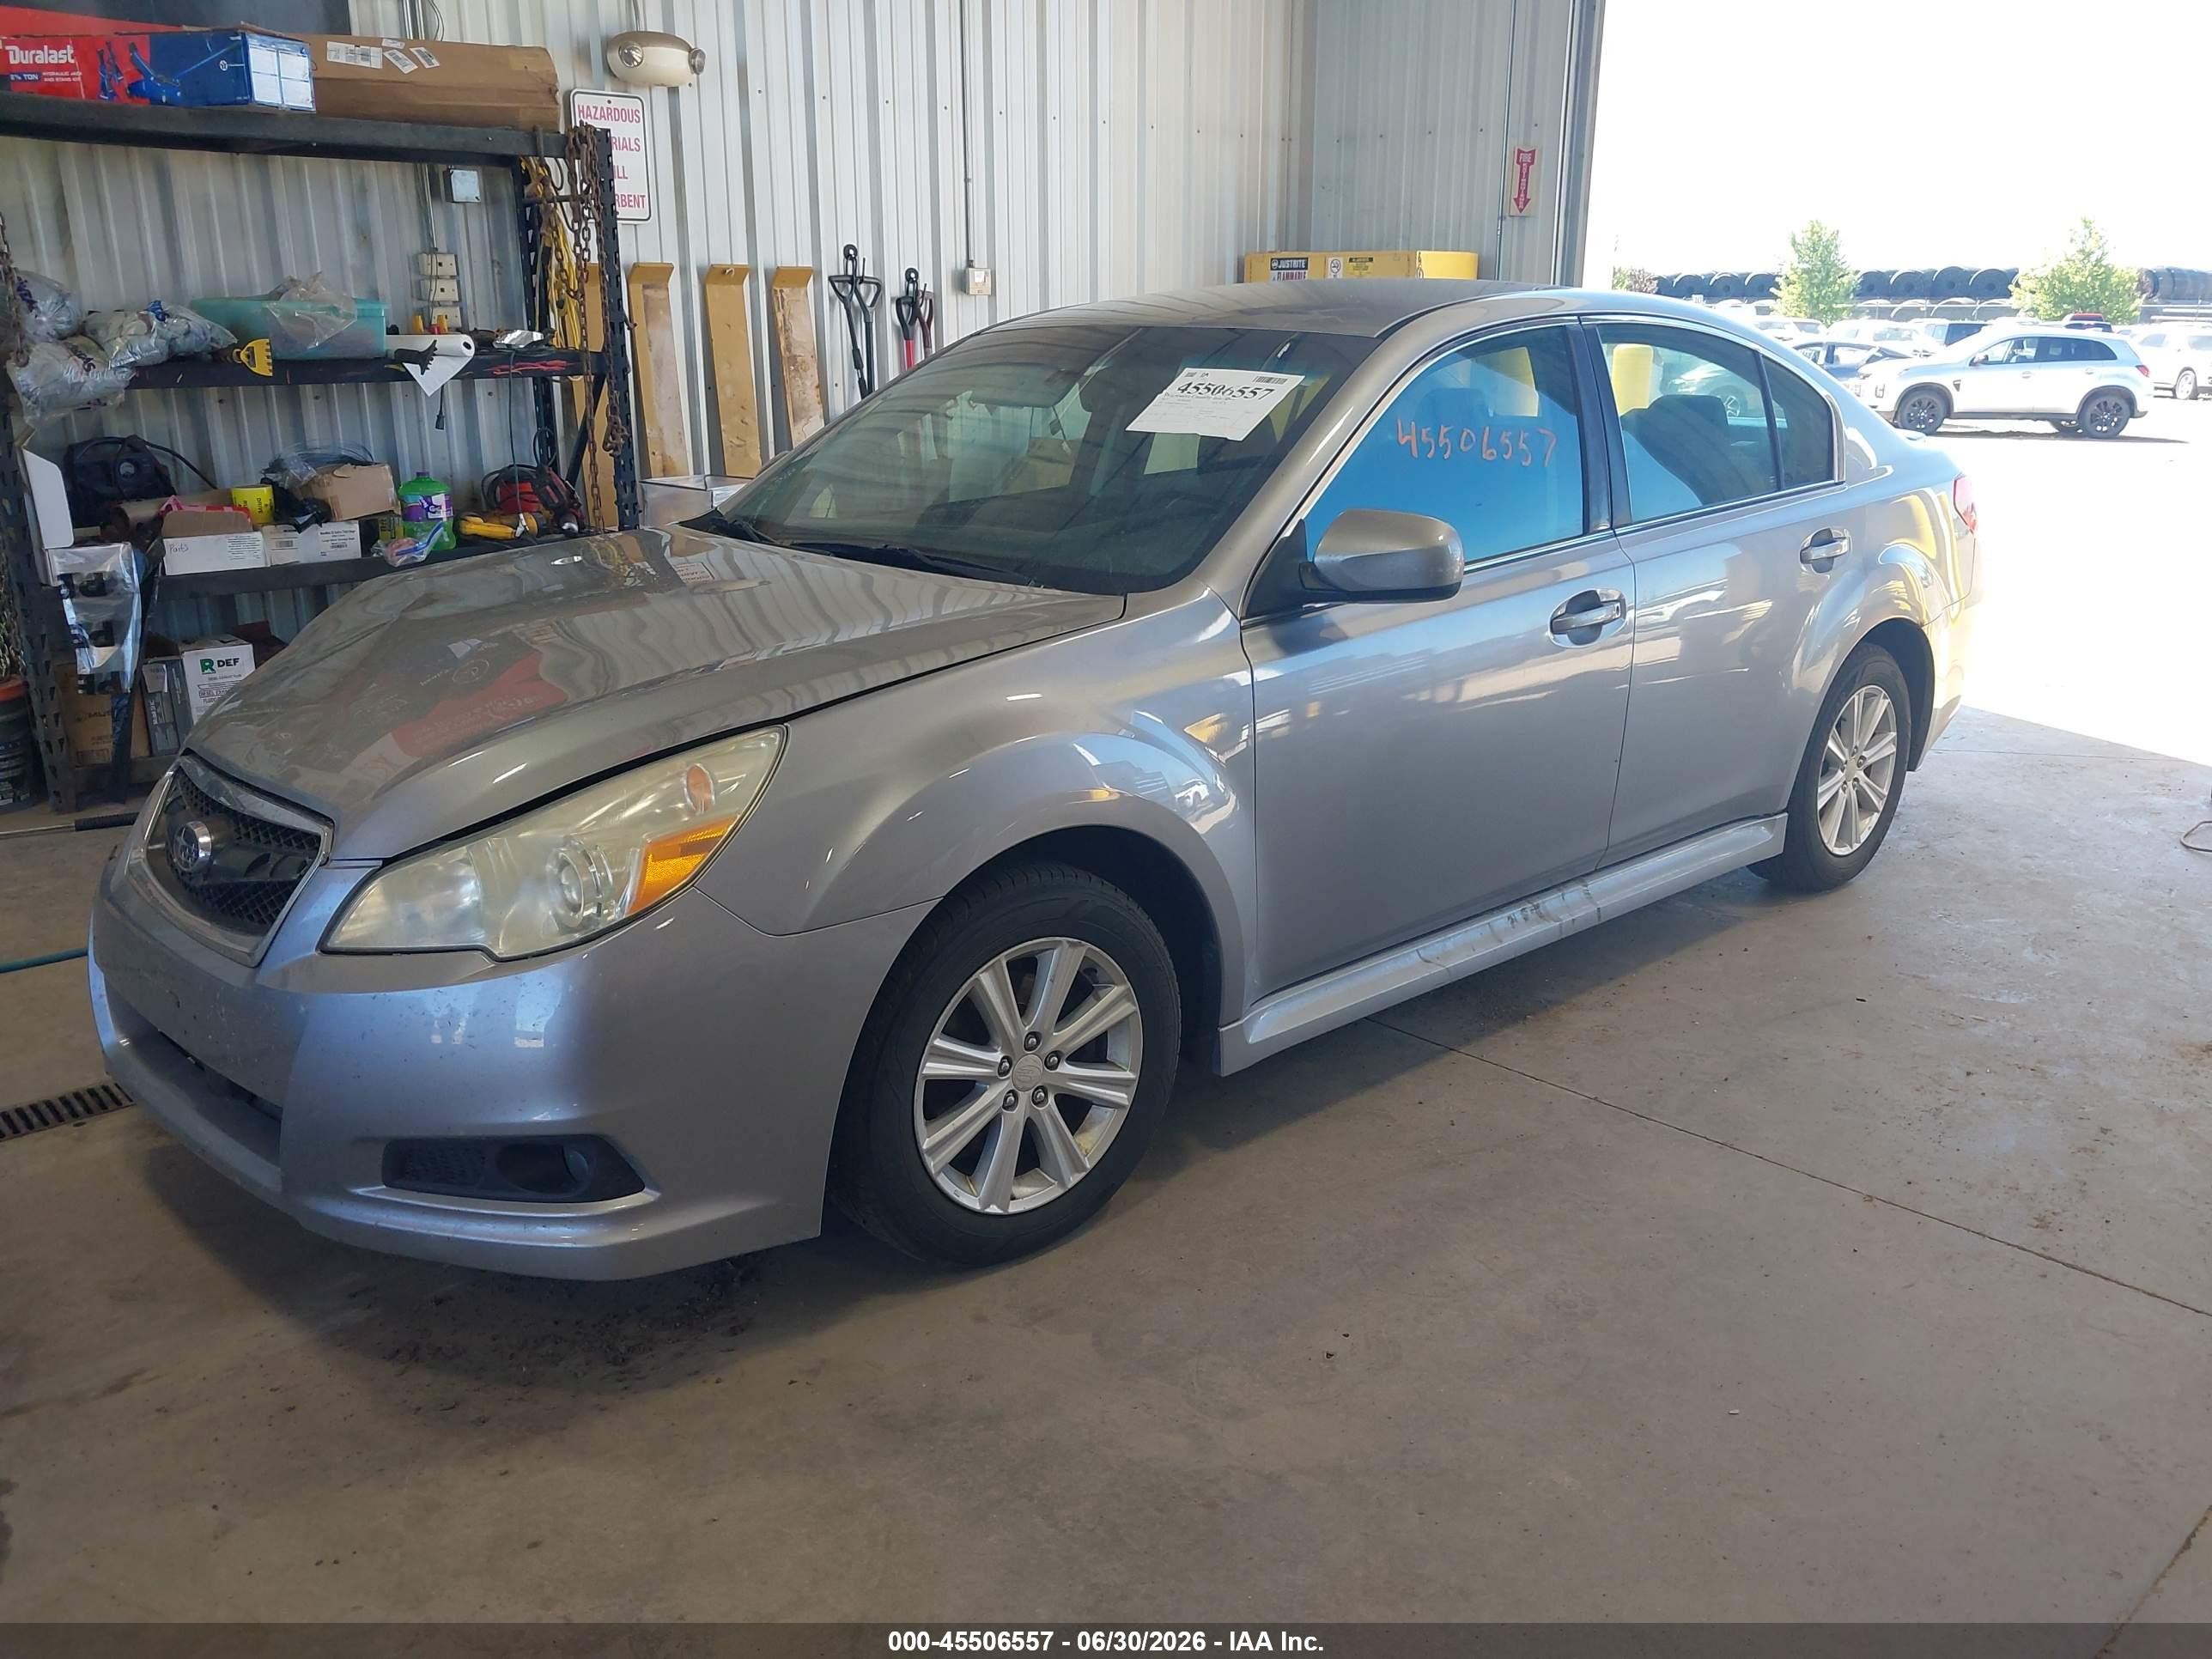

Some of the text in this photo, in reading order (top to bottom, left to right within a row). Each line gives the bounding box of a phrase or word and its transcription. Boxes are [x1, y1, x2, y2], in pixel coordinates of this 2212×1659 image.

[5, 45, 76, 64] Duralast
[578, 104, 641, 124] HAZARDOUS
[611, 136, 641, 152] RIALS
[613, 165, 629, 179] ILL
[614, 192, 646, 209] RBENT
[1278, 258, 1306, 269] JUSTRITE
[1177, 381, 1276, 401] 45506557
[1397, 416, 1557, 467] 45506557
[216, 657, 240, 668] DEF
